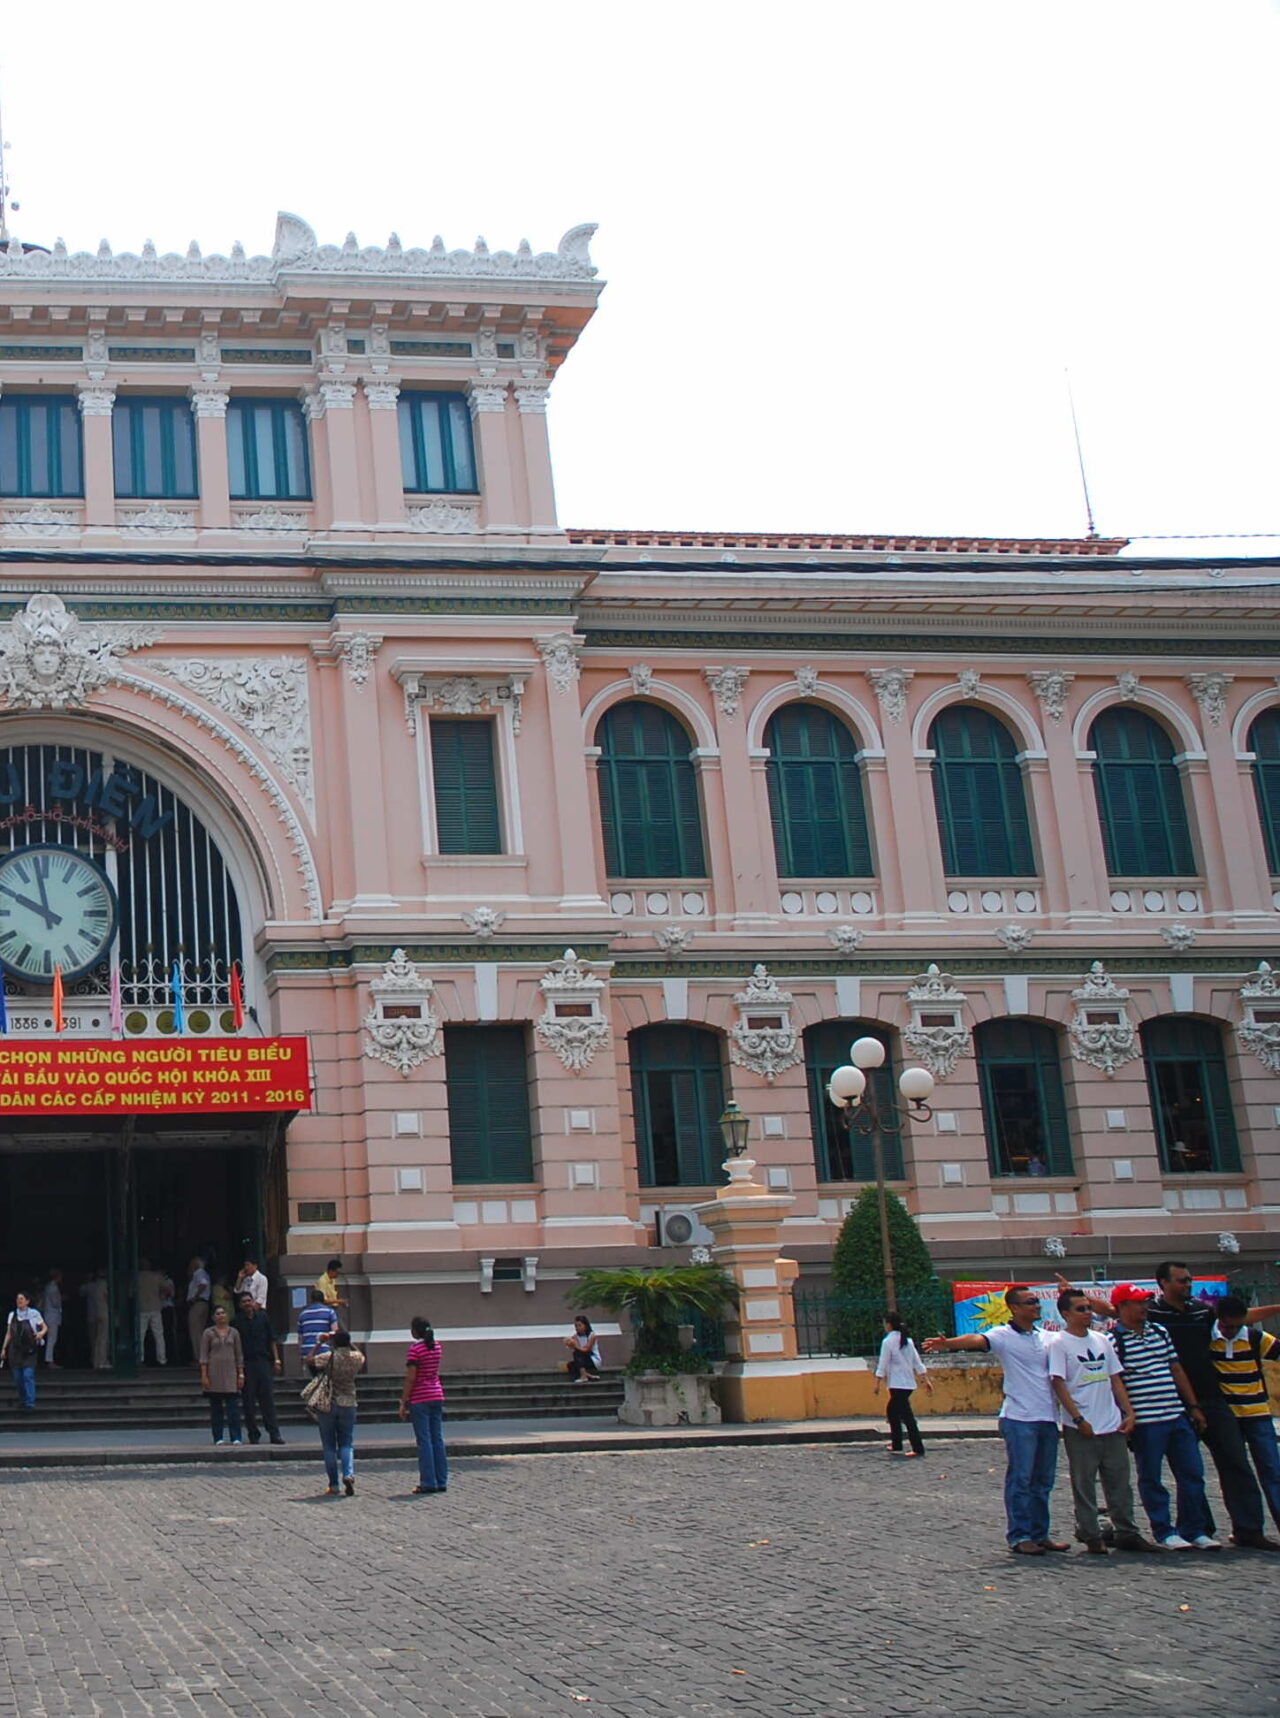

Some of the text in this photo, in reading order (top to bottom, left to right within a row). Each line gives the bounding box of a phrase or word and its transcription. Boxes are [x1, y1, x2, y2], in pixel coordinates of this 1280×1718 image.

[10, 1016, 82, 1030] 1886 891
[57, 1048, 127, 1065] NHỮNG
[131, 1046, 193, 1064] NGƯỜI
[198, 1047, 243, 1063] TIÊU
[247, 1042, 292, 1061] BIỂU
[23, 1067, 60, 1086] BẦU
[63, 1068, 101, 1086] VÀO
[104, 1067, 153, 1086] QUỐC
[157, 1068, 188, 1087] HỘI
[193, 1067, 241, 1084] KHÓA
[244, 1068, 272, 1083] XIII
[0, 1090, 37, 1107] DÂN
[40, 1089, 77, 1107] CÁC
[80, 1087, 117, 1107] CẤP
[120, 1090, 177, 1109] NHIỆM
[181, 1088, 206, 1105] KỲ
[210, 1090, 249, 1104] 2011
[265, 1090, 305, 1103] 2016
